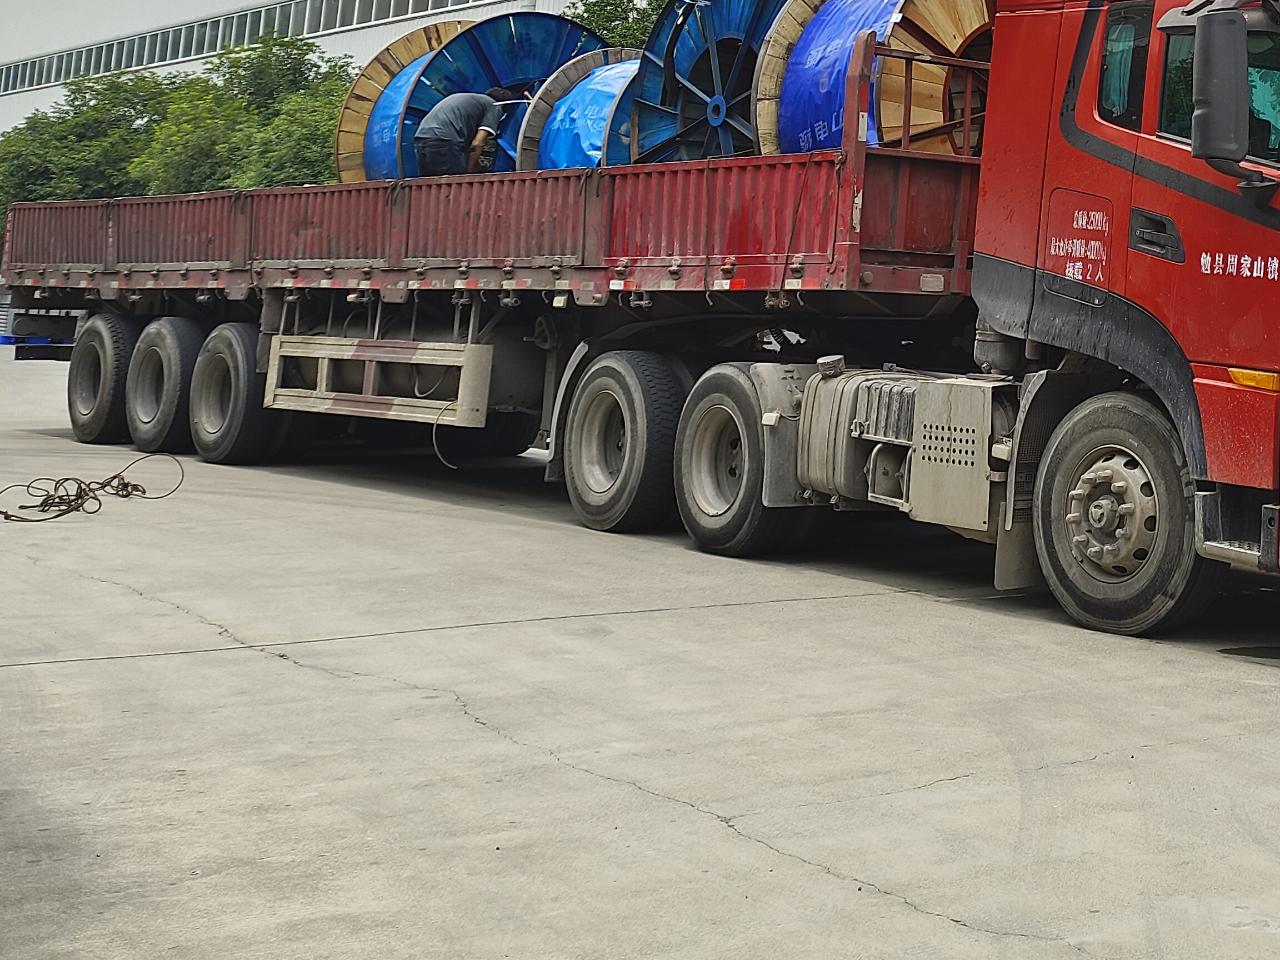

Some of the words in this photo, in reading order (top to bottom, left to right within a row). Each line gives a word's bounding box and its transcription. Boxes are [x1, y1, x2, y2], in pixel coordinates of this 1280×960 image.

[1200, 251, 1279, 281] 勉县周家山镇
